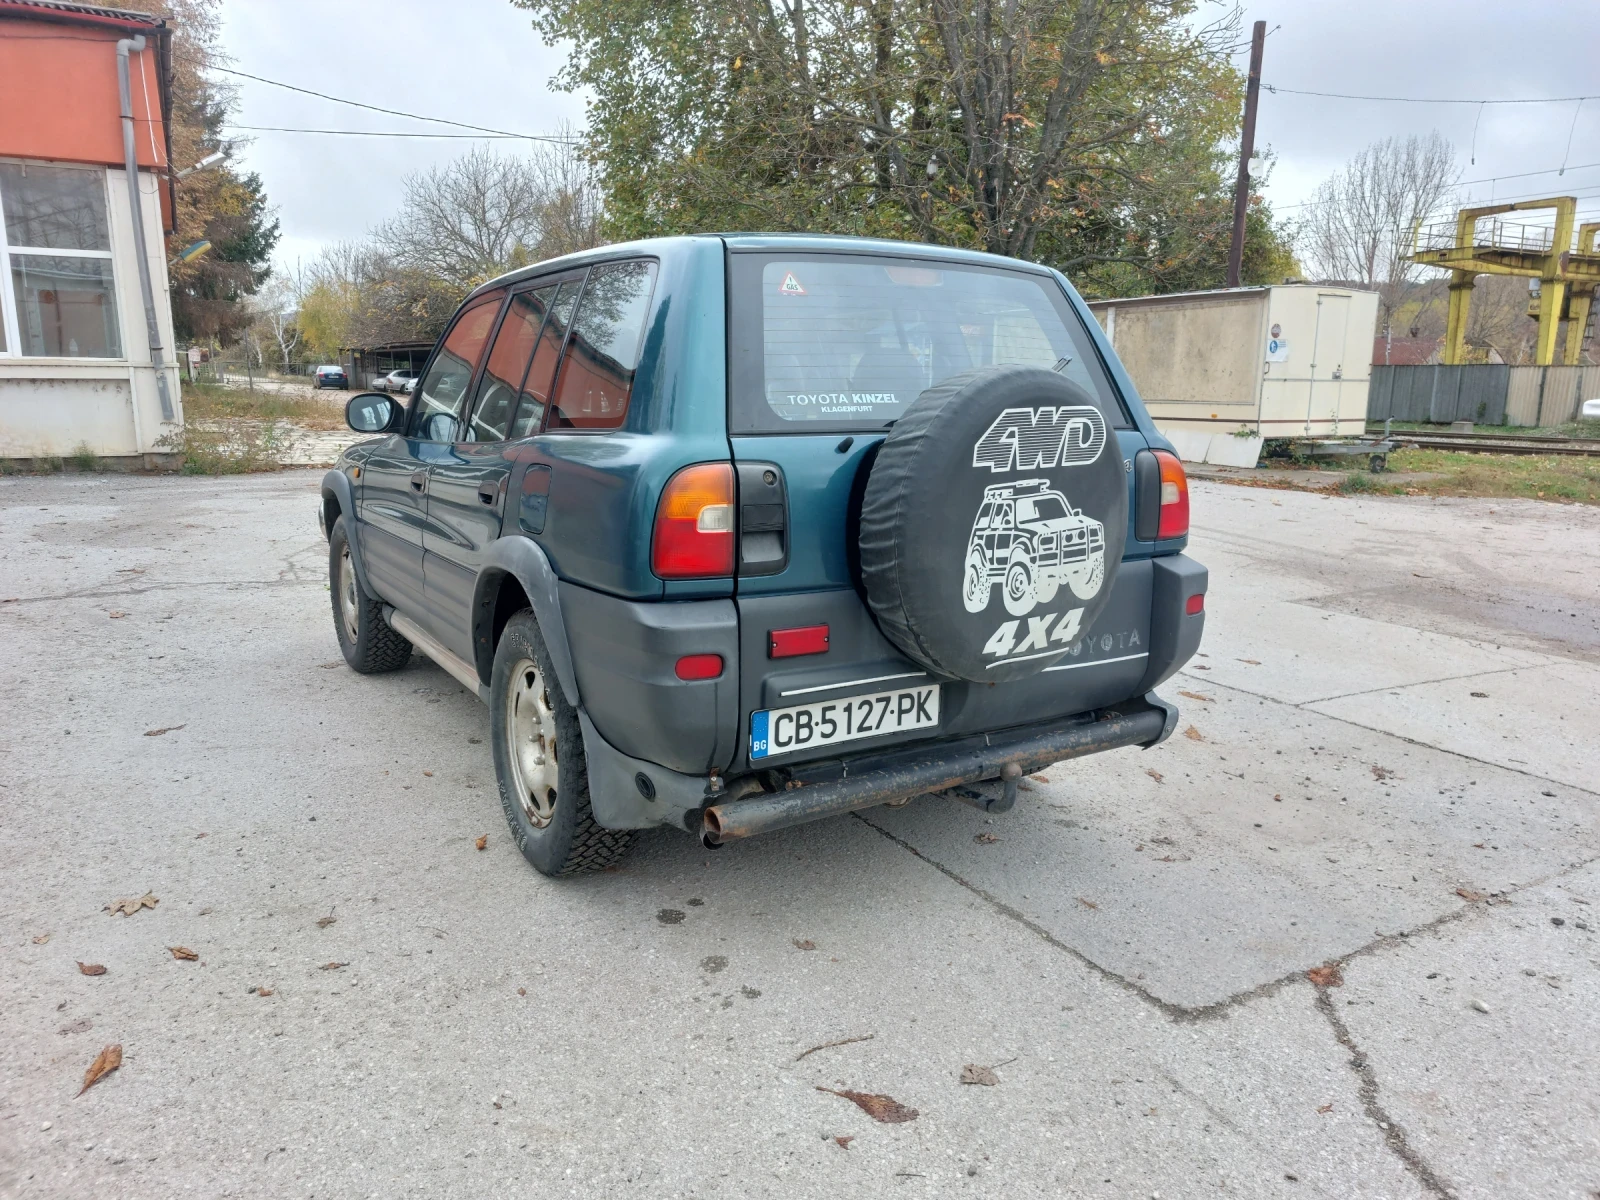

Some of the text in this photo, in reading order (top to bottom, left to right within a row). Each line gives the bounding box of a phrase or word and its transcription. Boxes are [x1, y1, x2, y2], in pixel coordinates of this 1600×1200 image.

[787, 393, 899, 405] TOYOTA KINZEL
[821, 405, 873, 413] KLAGENFURT
[972, 405, 1107, 473] 4WD
[1069, 628, 1141, 657] OYOTA
[753, 740, 767, 752] BG
